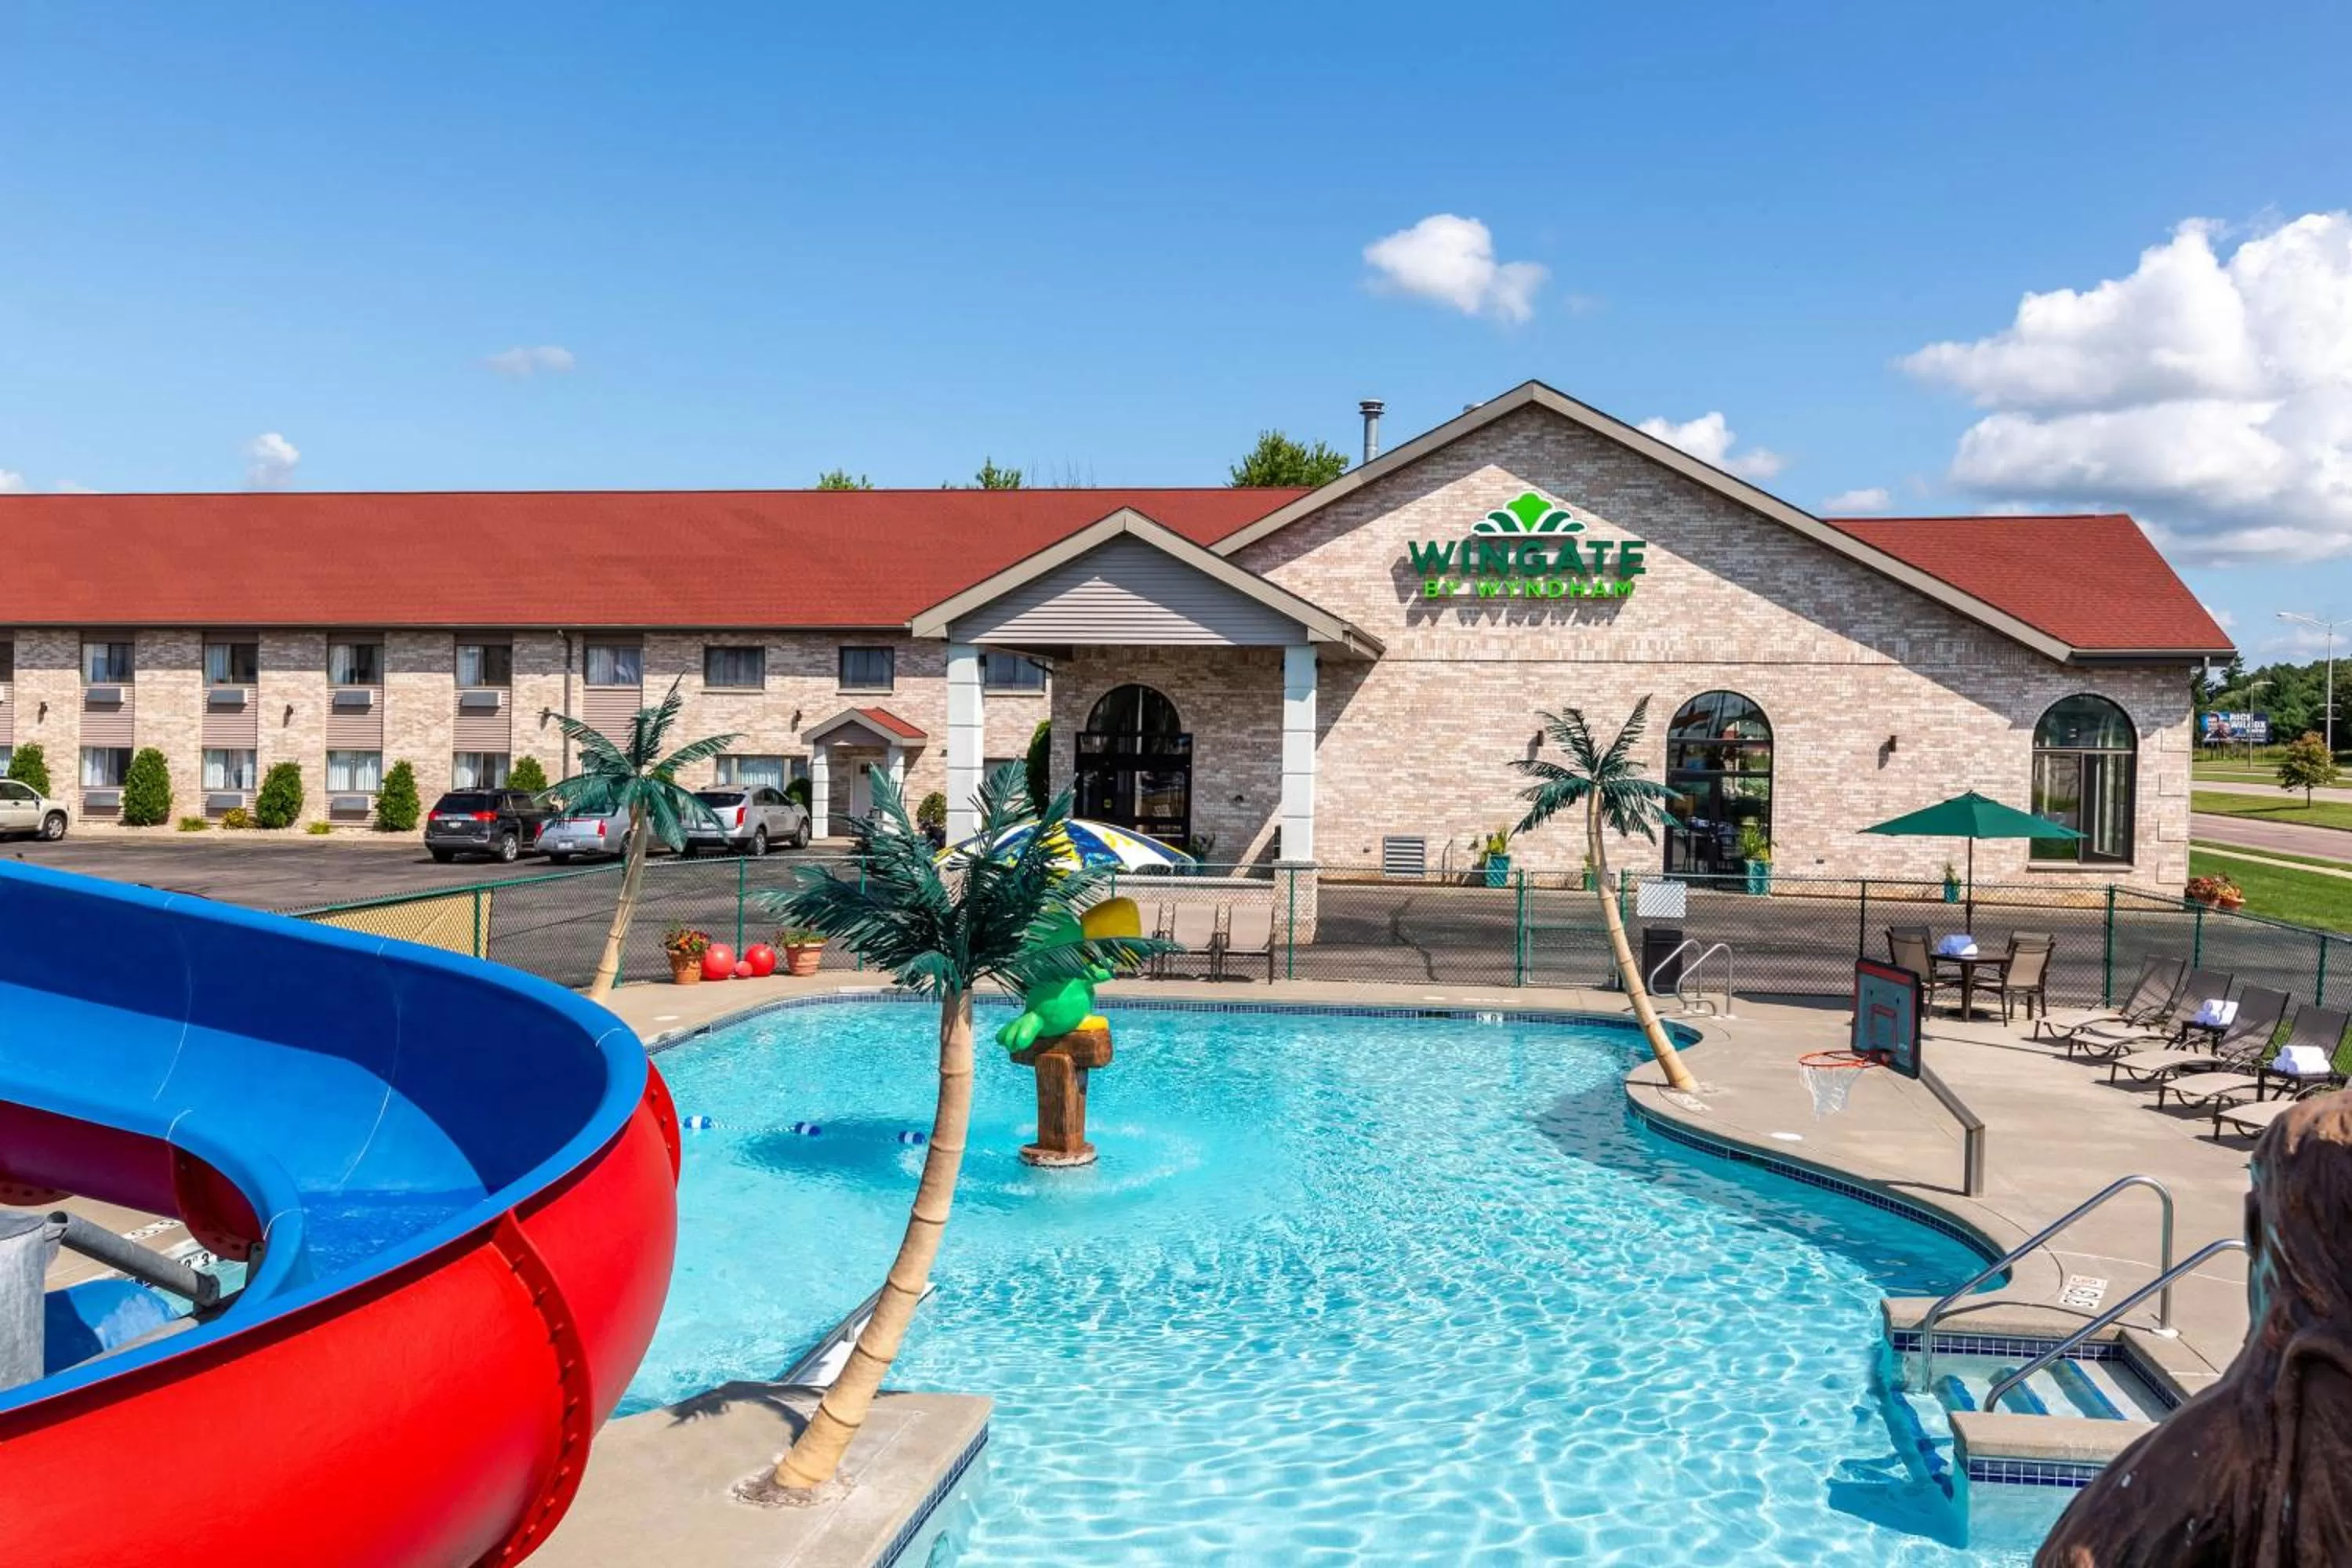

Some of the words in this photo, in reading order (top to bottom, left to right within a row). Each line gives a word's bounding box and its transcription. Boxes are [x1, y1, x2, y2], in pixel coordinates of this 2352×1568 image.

[1408, 539, 1646, 577] WINGATE
[1424, 579, 1461, 598] BY
[1475, 579, 1636, 599] WYNDHAM
